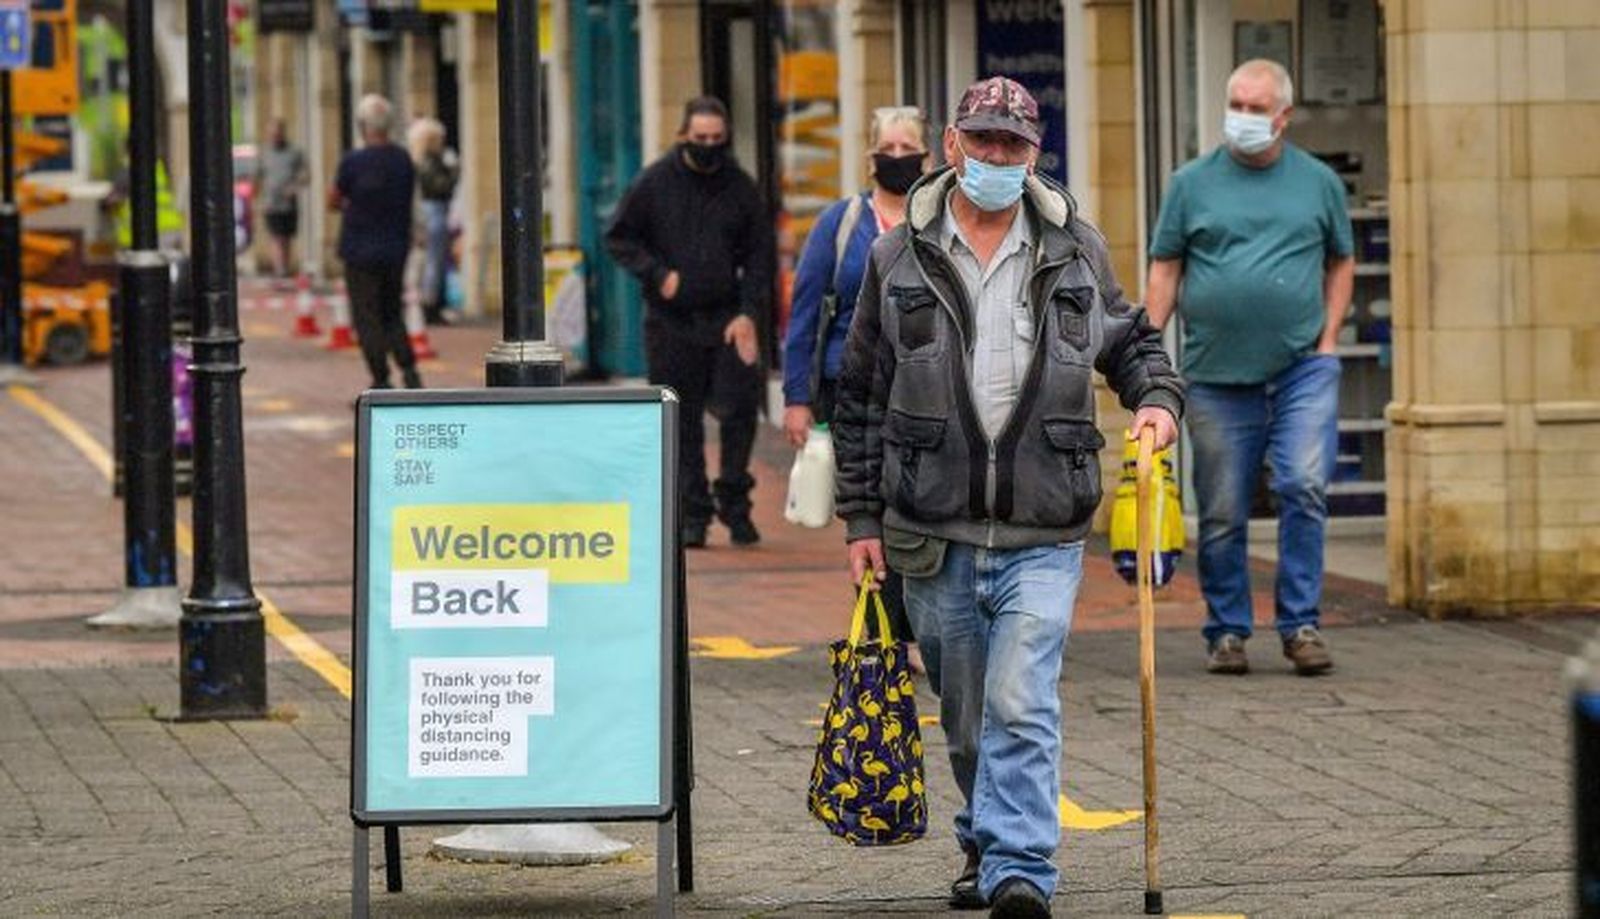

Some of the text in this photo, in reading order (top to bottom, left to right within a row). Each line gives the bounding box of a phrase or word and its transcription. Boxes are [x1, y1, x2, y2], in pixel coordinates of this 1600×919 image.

[395, 423, 467, 436] RESPECT
[395, 437, 459, 449] OTHERS
[395, 459, 432, 472] STAY
[394, 472, 435, 486] SAFE
[411, 524, 615, 560] Welcome
[411, 580, 520, 616] Back
[421, 670, 542, 689] Thank you for
[421, 690, 534, 709] following the
[420, 709, 494, 728] physical
[420, 727, 512, 746] distancing
[420, 746, 504, 766] guidance.
